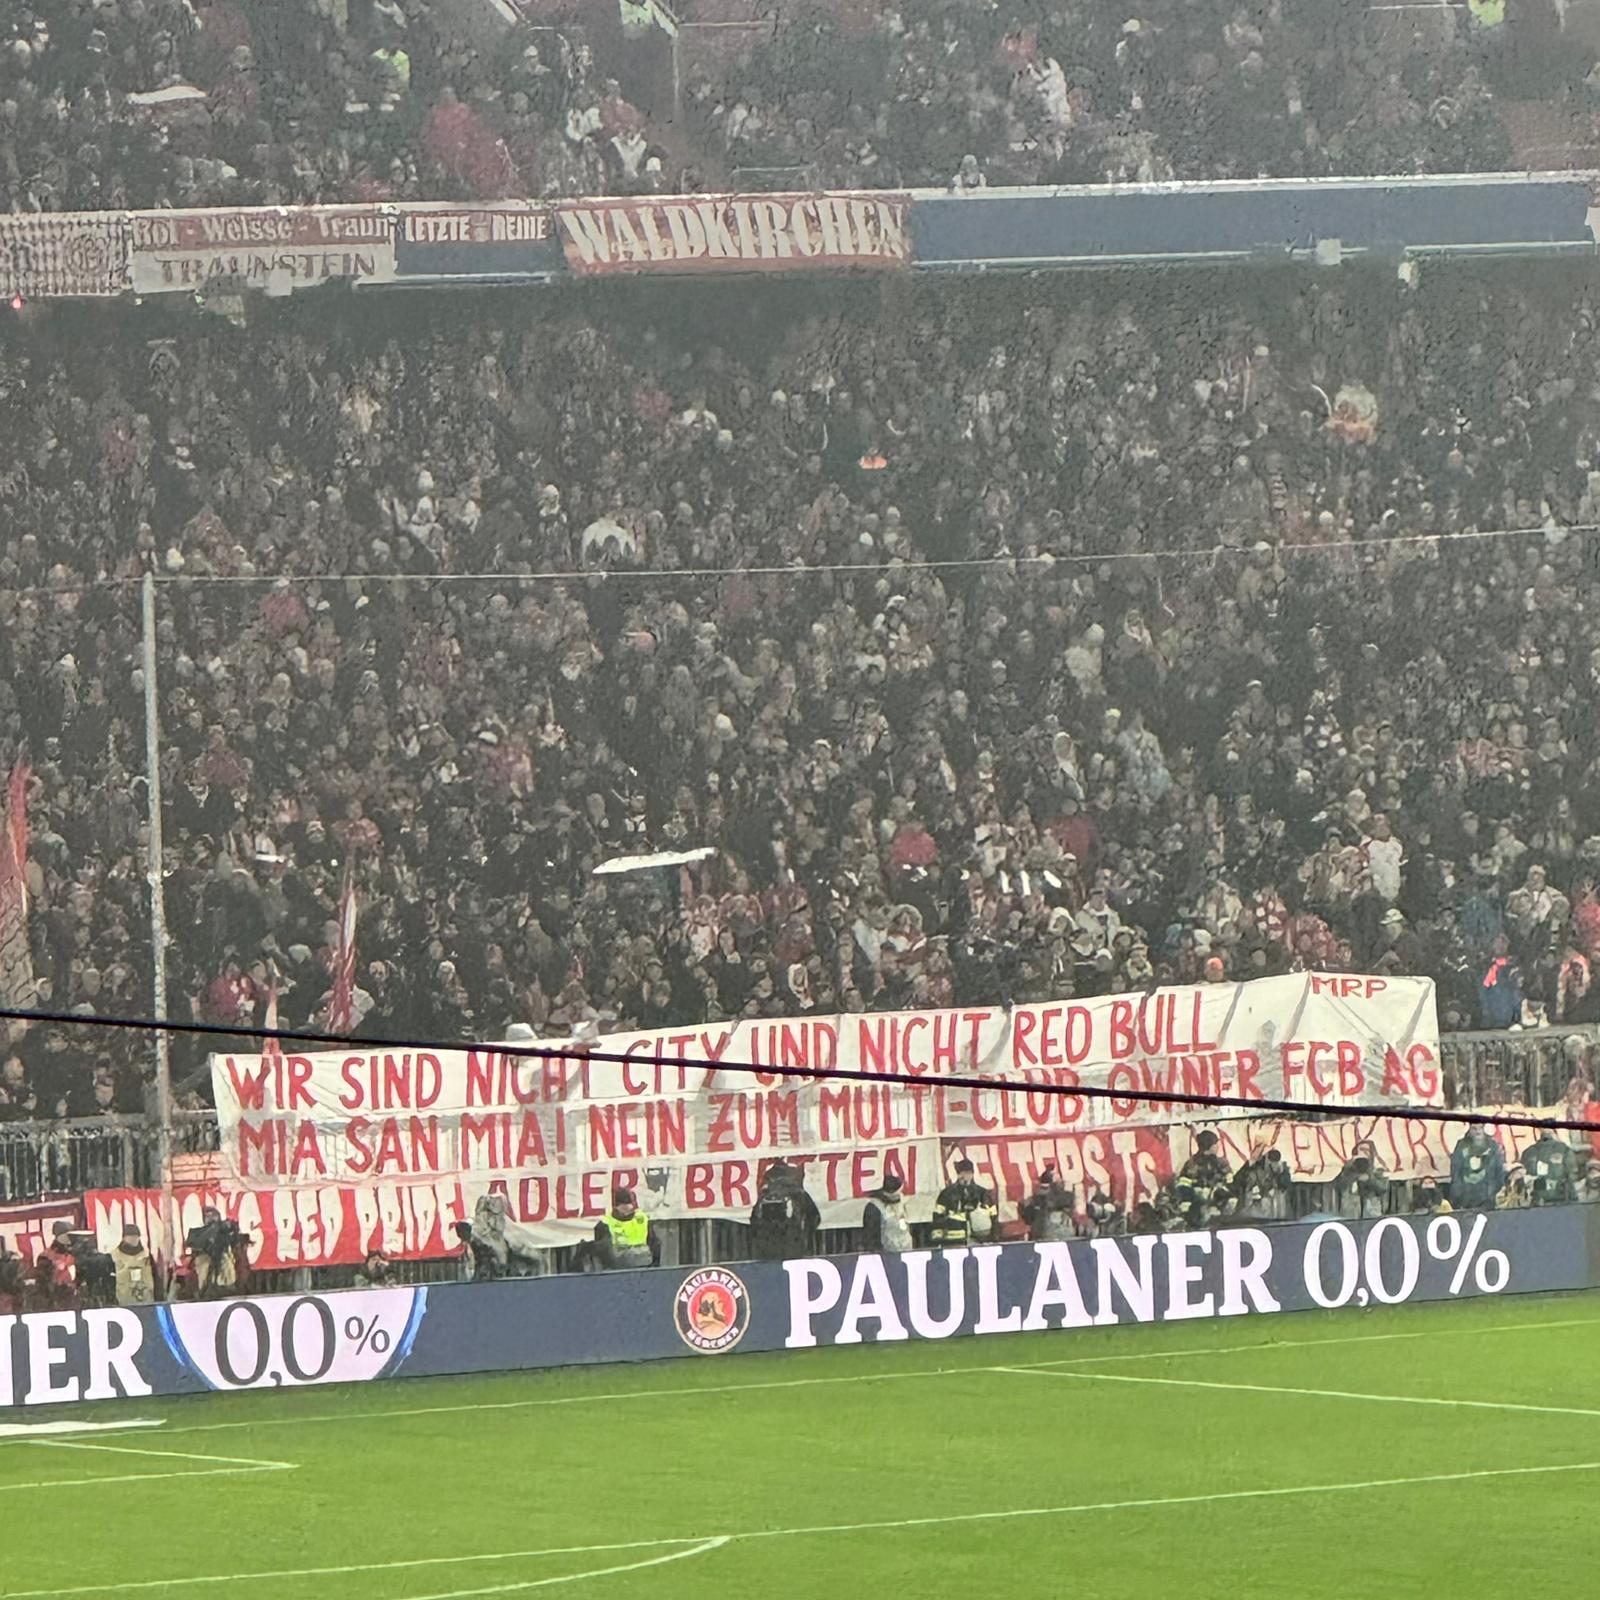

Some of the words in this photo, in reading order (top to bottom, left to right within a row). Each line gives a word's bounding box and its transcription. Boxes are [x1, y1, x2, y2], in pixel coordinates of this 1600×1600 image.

[405, 215, 471, 242] LETZTE
[560, 200, 905, 263] WALDKIRCHEN
[1310, 976, 1387, 999] MRP
[226, 1055, 318, 1112] WIR
[339, 1053, 443, 1110] SIND
[466, 1048, 590, 1105] NICHT
[623, 1031, 731, 1095] CITY
[750, 1022, 837, 1087] UND
[859, 1012, 991, 1075] NICHT
[1012, 1005, 1092, 1069] RED
[1109, 991, 1218, 1060] BULL
[239, 1118, 326, 1176] MIA
[345, 1115, 439, 1174] SAN
[460, 1106, 566, 1170] MIA!
[588, 1097, 686, 1161] NEIN
[707, 1090, 799, 1153] ZUM
[819, 1066, 1086, 1142] MULTI-CLUB
[1106, 1049, 1264, 1116] OWNER
[1281, 1039, 1365, 1097] FCB
[1381, 1042, 1438, 1098] AG
[271, 1188, 342, 1260] RED
[354, 1181, 465, 1257] PRIDE
[488, 1168, 639, 1223] ADLER
[782, 1227, 1281, 1348] PAULANER
[0, 1307, 152, 1406] ER
